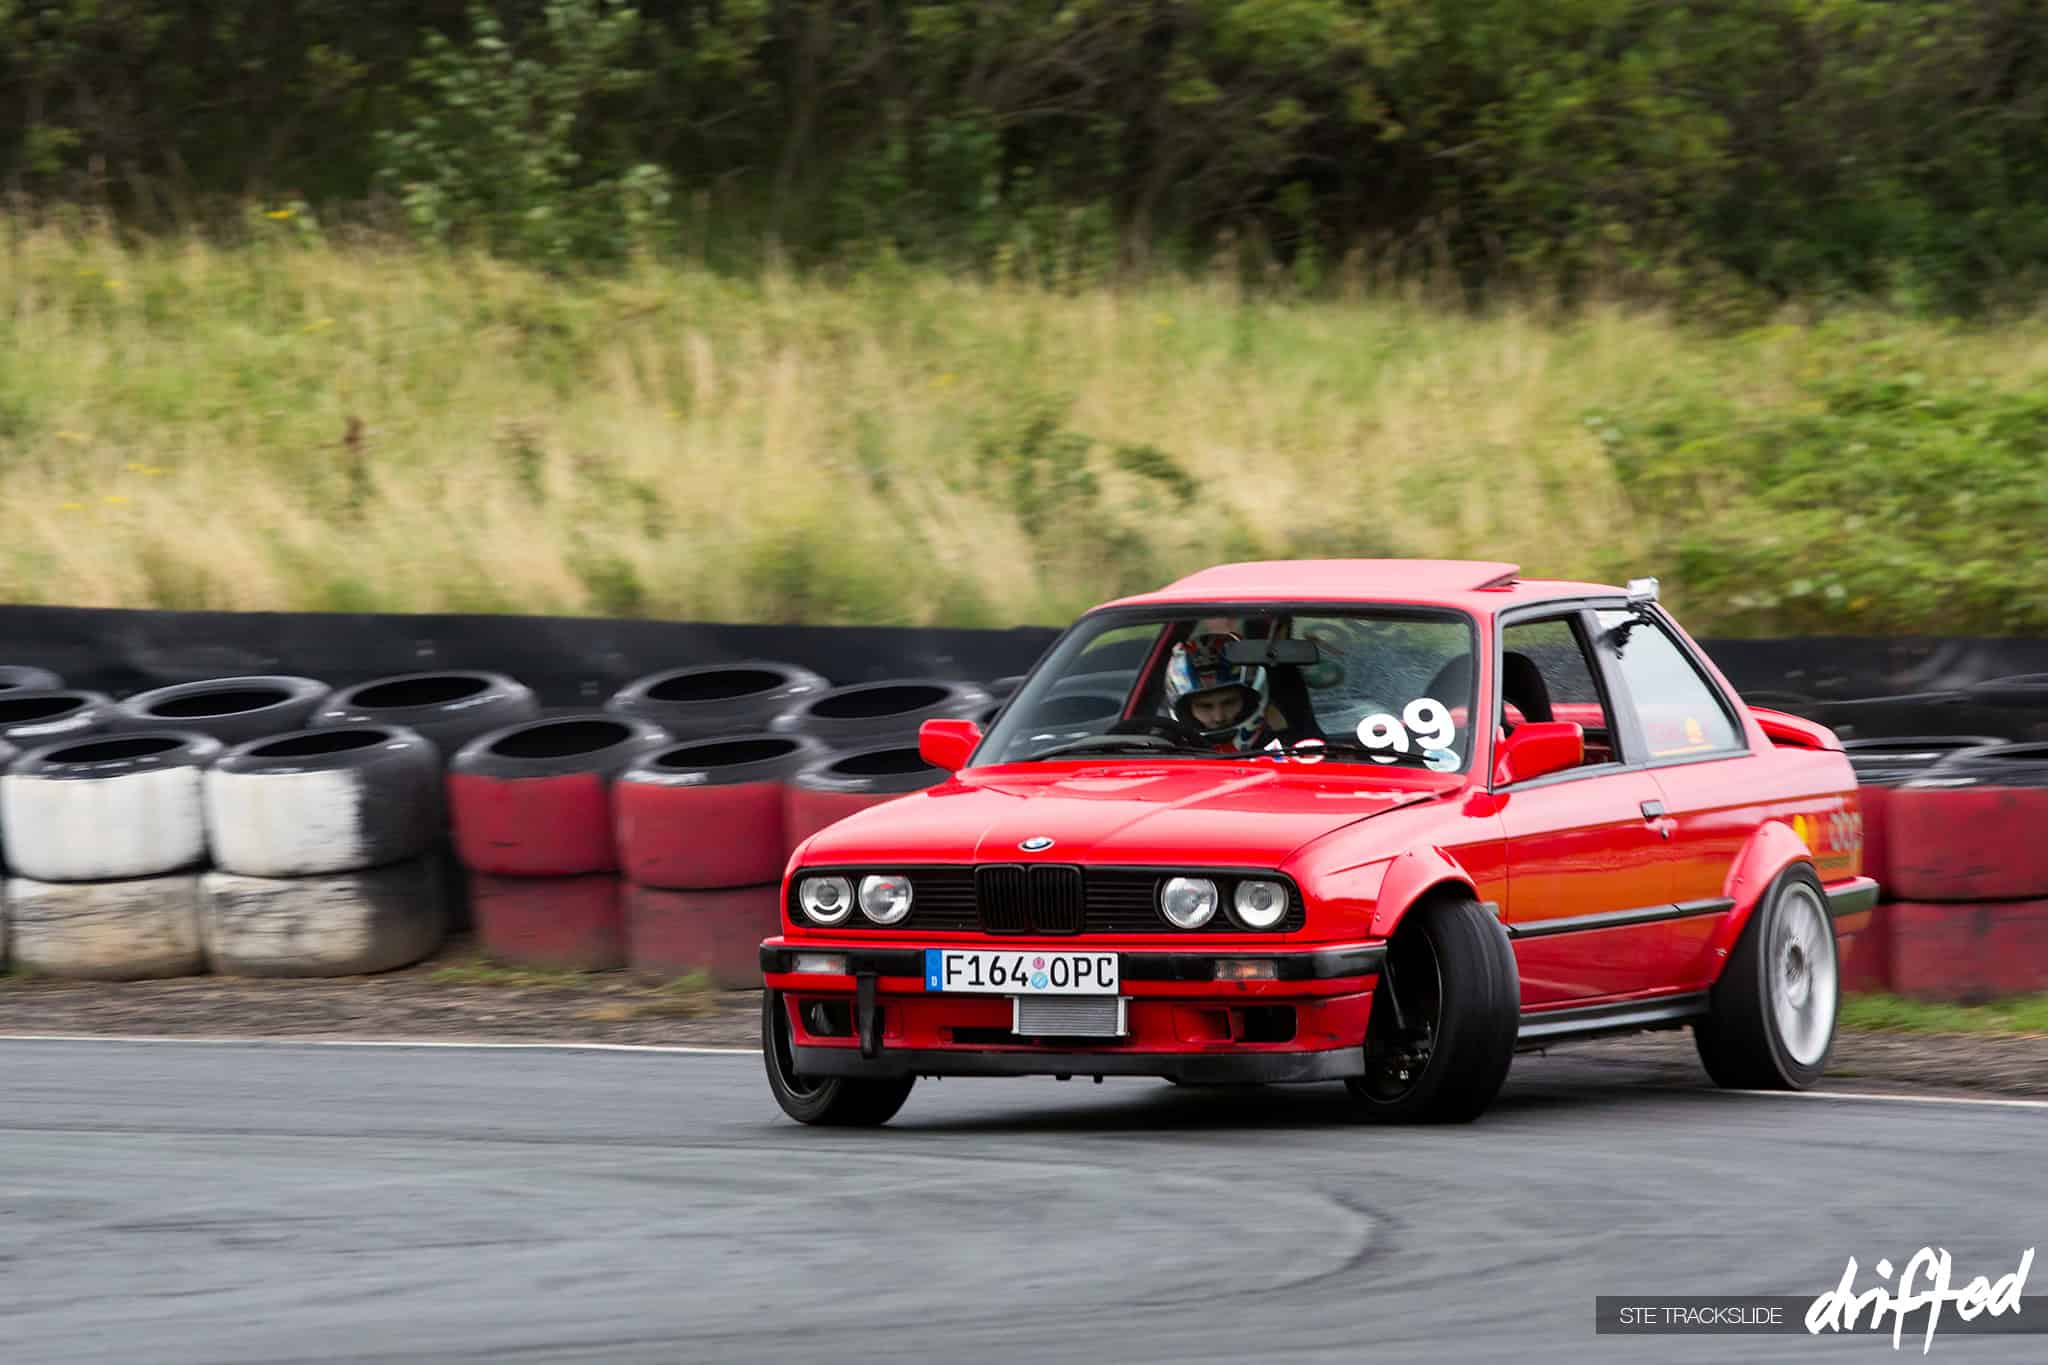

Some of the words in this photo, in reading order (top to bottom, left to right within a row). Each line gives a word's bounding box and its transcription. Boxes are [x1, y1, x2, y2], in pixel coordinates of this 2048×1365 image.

[1356, 697, 1456, 764] 99
[945, 954, 1029, 987] F164
[1049, 956, 1114, 988] OPC
